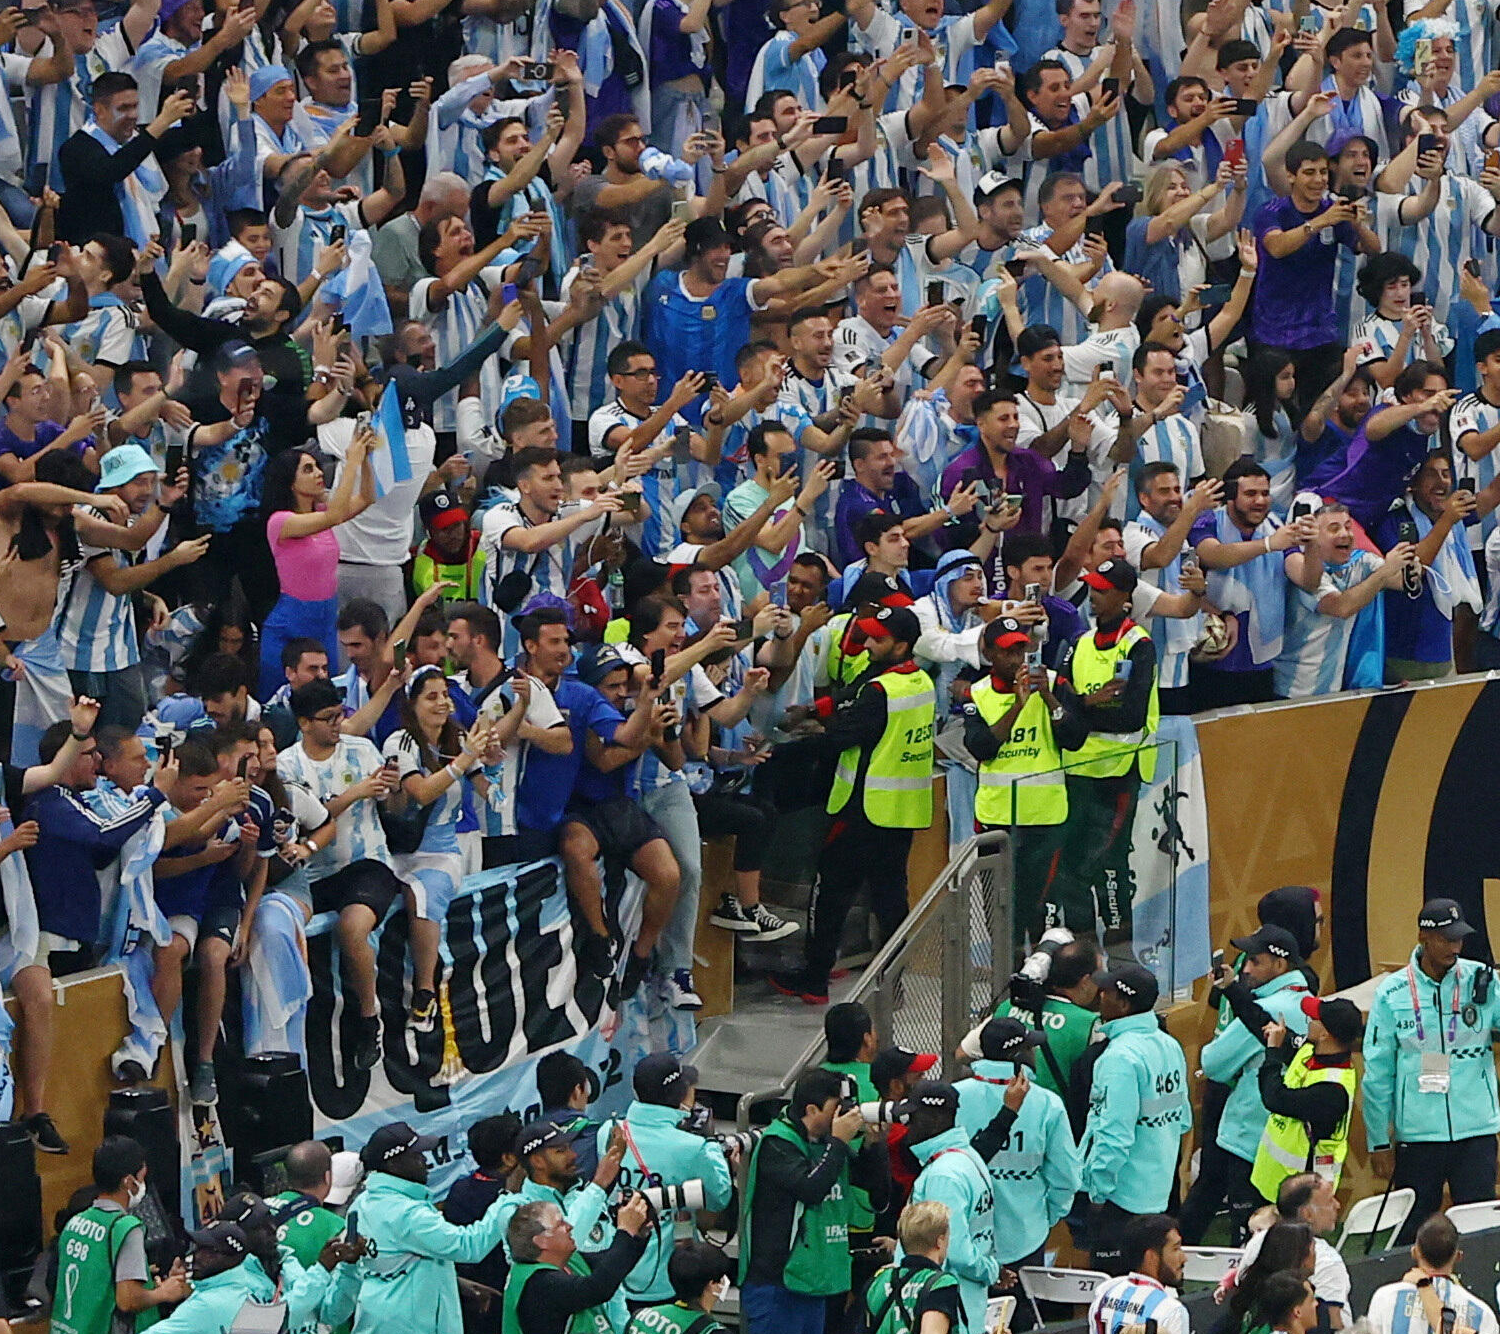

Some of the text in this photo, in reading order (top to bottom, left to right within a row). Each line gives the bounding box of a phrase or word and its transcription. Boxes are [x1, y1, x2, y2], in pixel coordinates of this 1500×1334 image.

[992, 745, 1041, 761] ecurity
[67, 1240, 88, 1261] 698
[1079, 1280, 1094, 1292] 27
